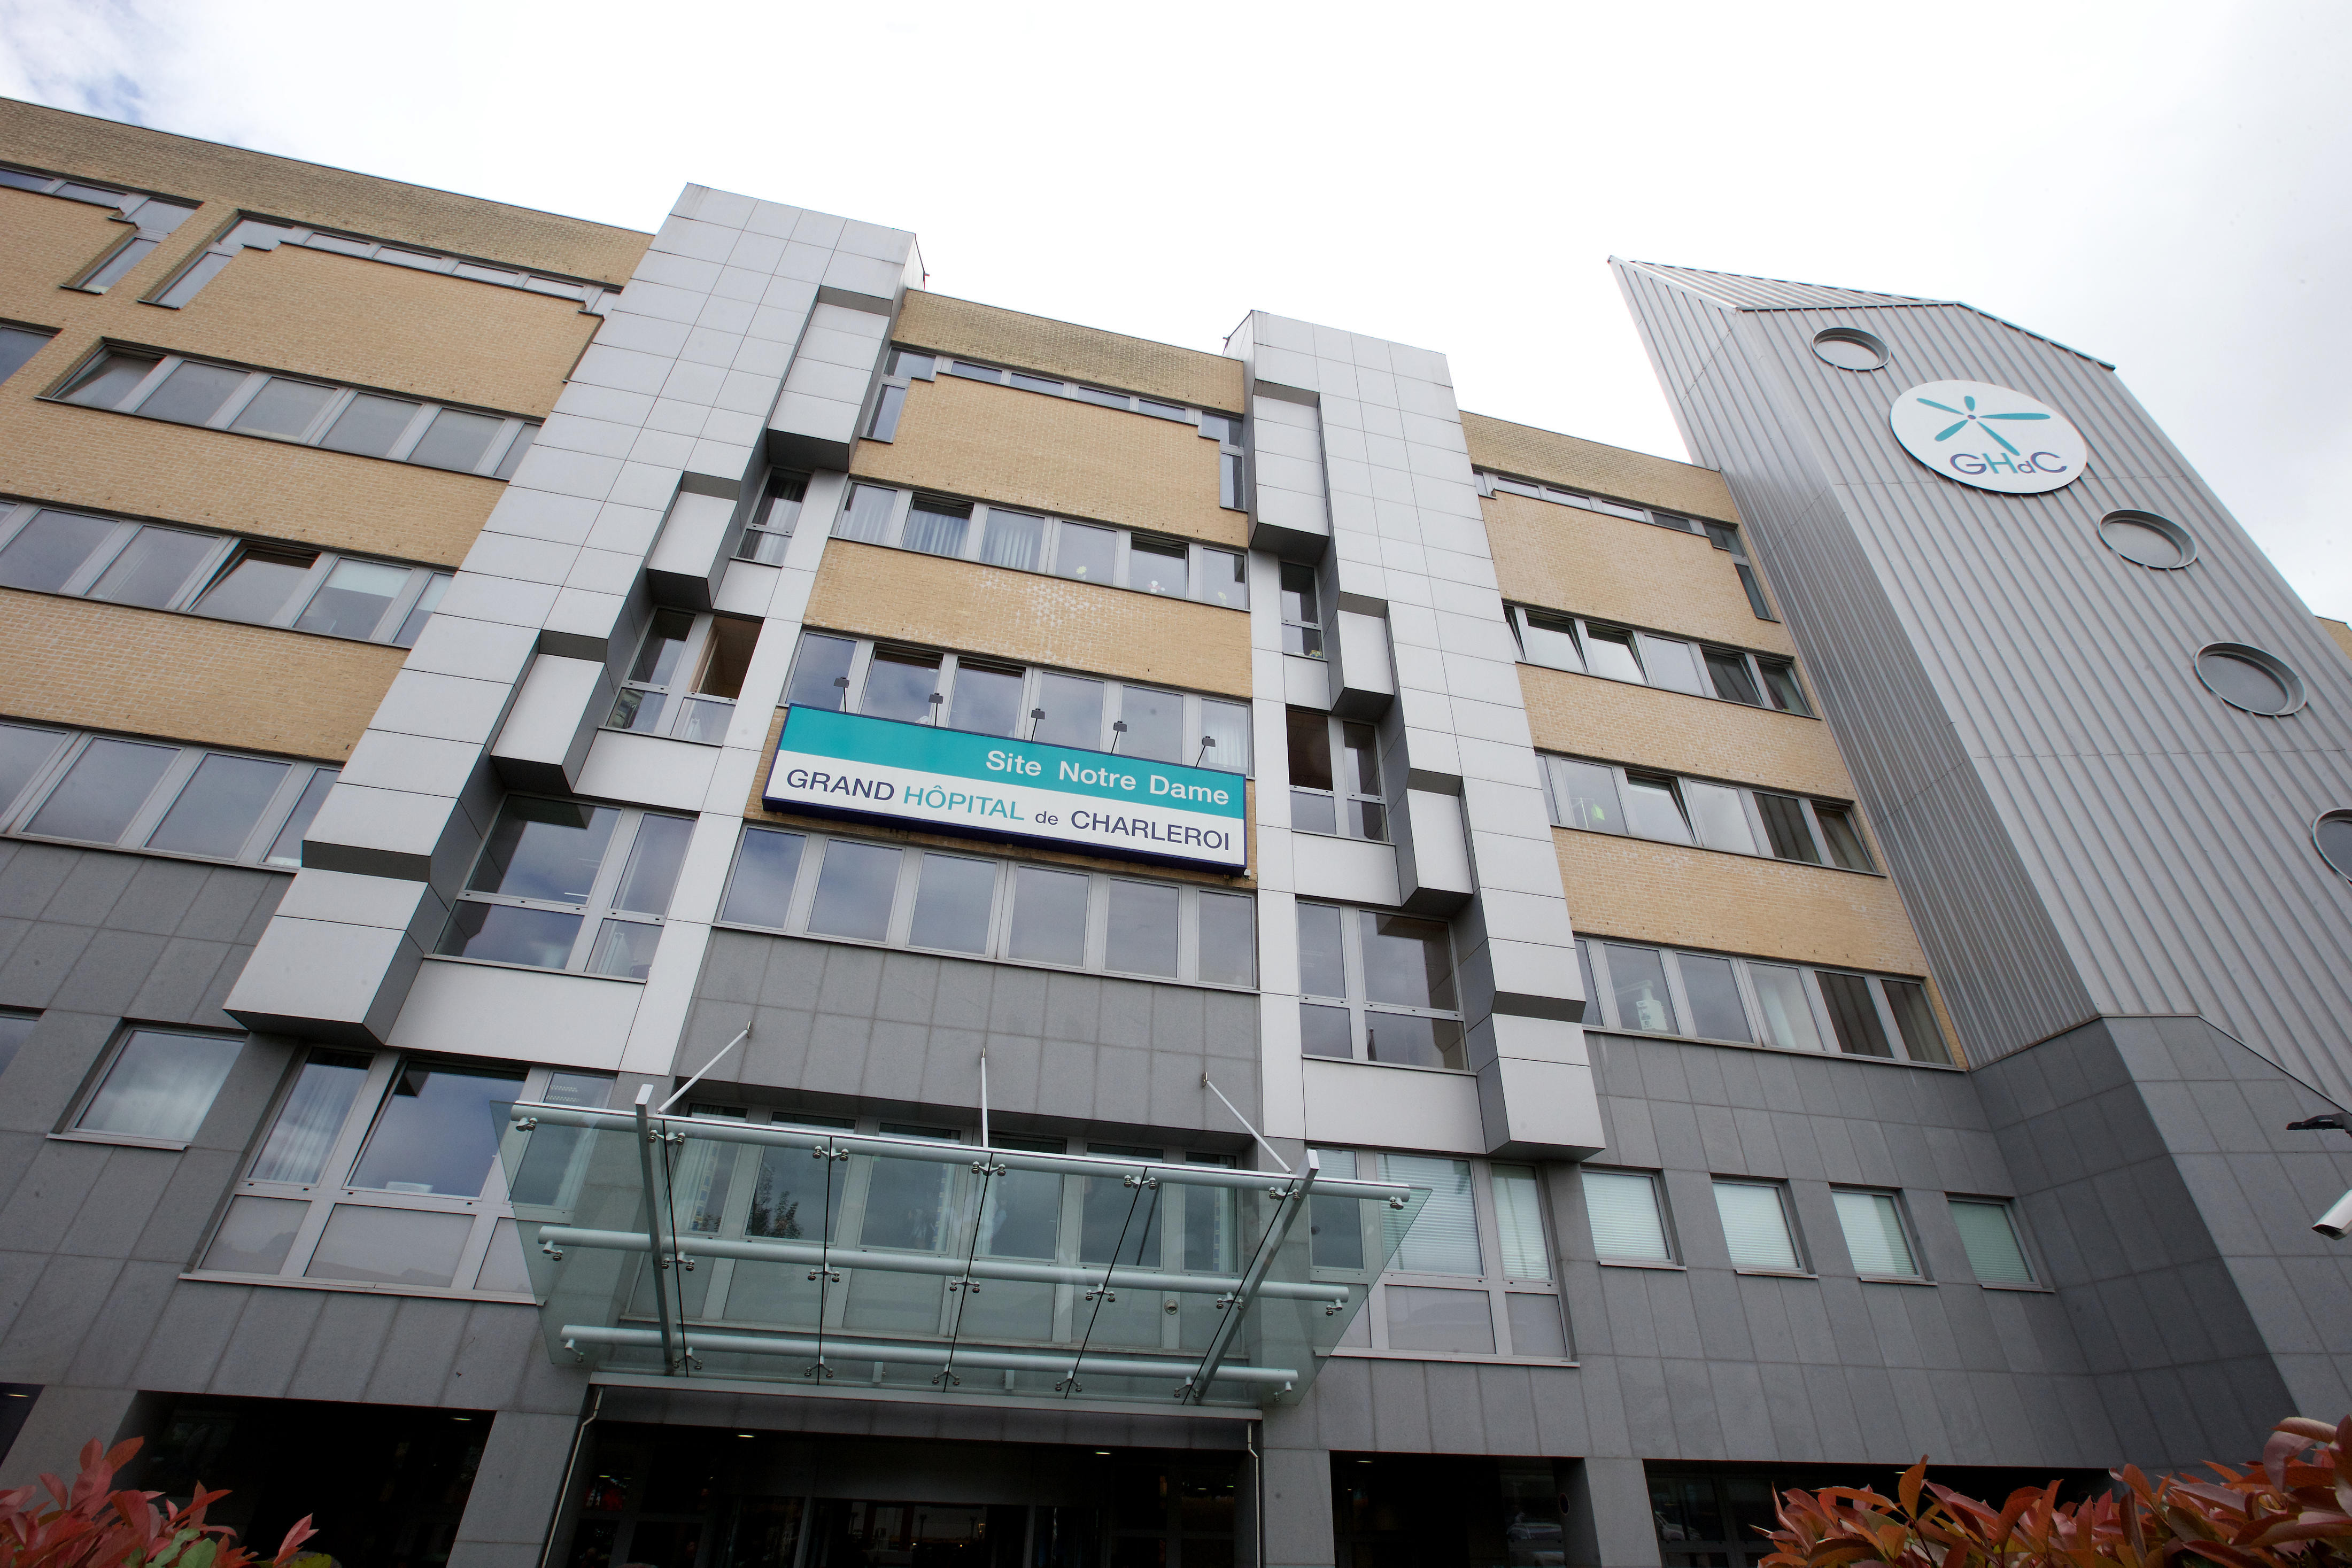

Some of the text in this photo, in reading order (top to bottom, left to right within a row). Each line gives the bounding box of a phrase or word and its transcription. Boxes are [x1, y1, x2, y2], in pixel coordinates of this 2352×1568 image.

[1950, 452, 2067, 475] GHdC
[986, 750, 1229, 805] Site Notre Dame
[787, 769, 1229, 851] GRAND HÔPITAL de CHARLEROI
